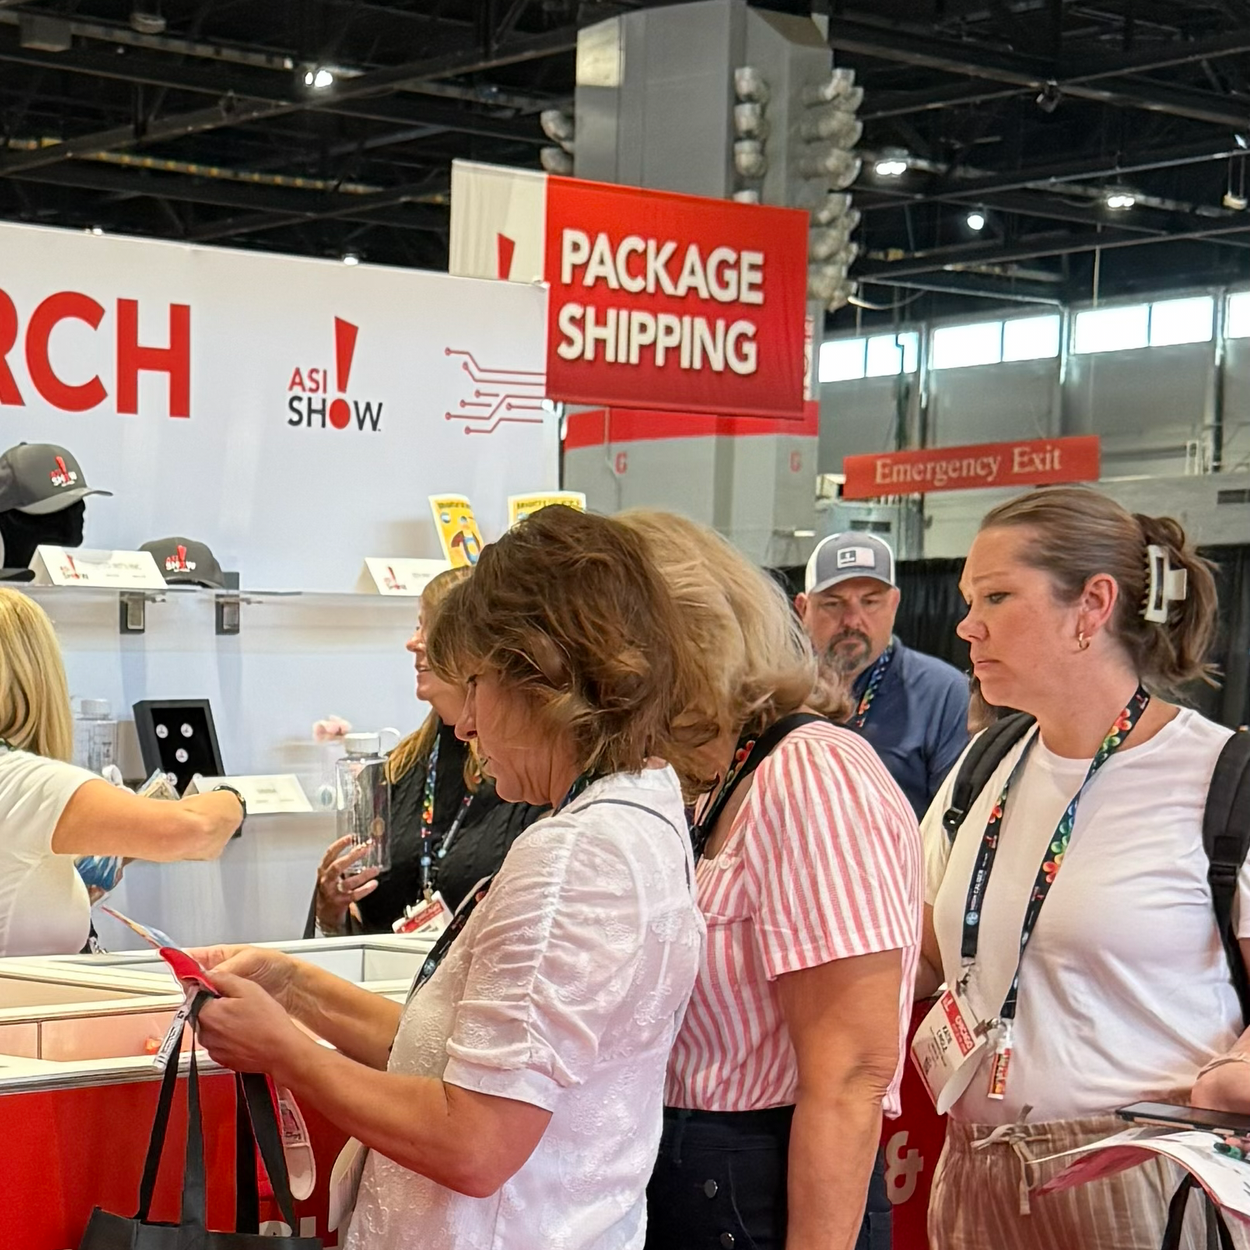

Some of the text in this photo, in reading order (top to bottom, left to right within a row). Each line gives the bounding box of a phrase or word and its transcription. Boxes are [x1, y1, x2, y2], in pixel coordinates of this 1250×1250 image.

[559, 229, 764, 305] PACKAGE
[557, 304, 757, 376] SHIPPING
[289, 367, 327, 393] ASI
[287, 396, 383, 432] SHOW
[874, 446, 1062, 486] Emergency Exit
